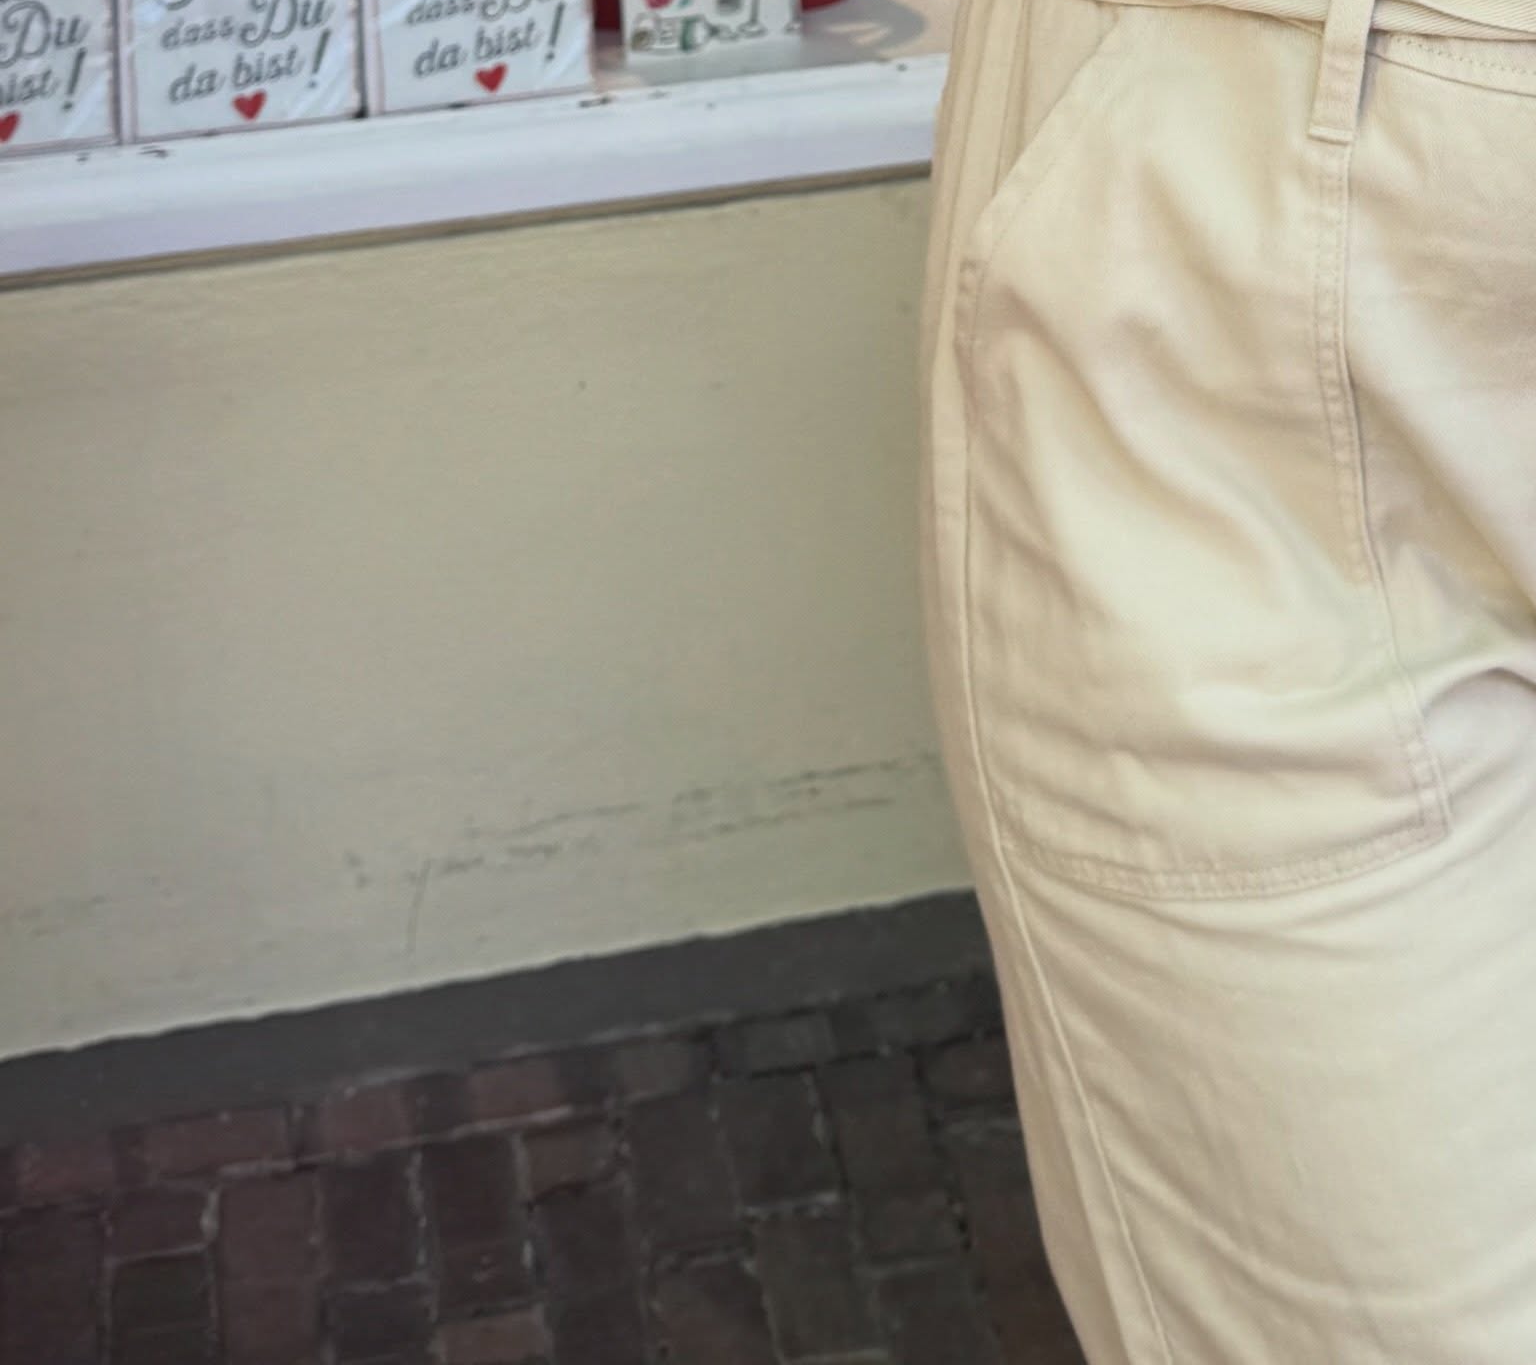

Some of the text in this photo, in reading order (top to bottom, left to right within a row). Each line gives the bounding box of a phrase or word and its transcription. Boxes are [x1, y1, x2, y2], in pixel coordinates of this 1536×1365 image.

[0, 0, 89, 70] Du
[414, 36, 470, 78] da
[0, 47, 87, 115] ist!
[168, 62, 225, 105] da
